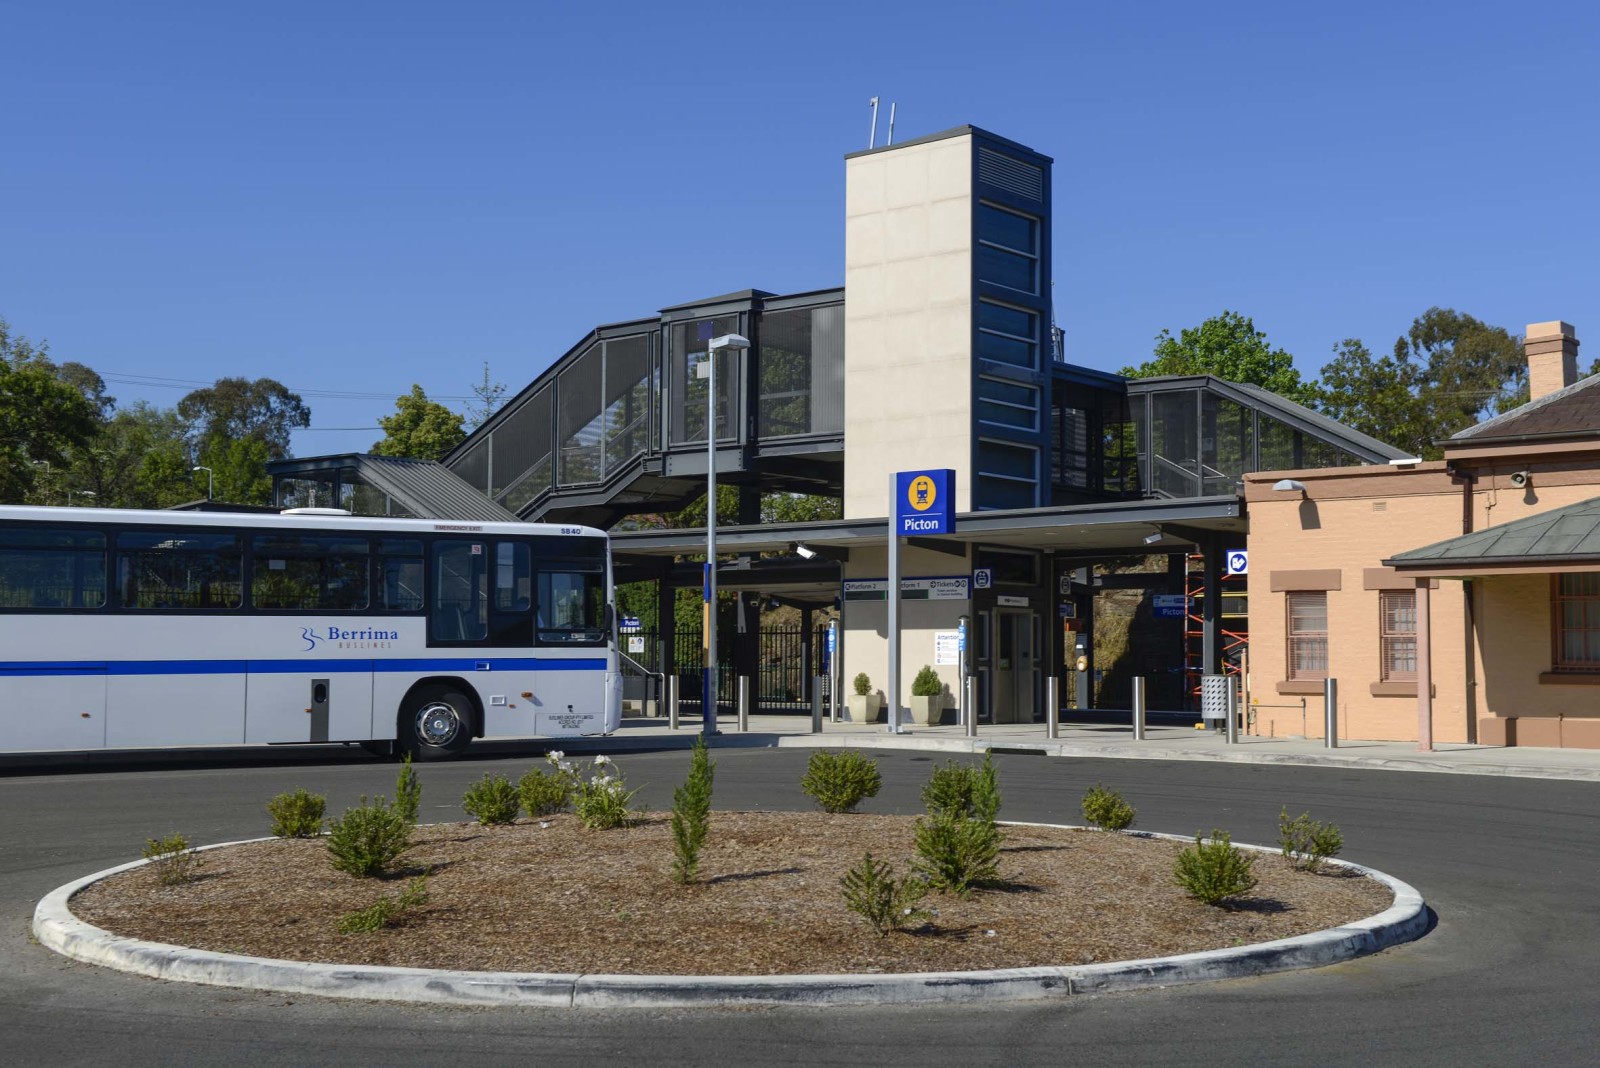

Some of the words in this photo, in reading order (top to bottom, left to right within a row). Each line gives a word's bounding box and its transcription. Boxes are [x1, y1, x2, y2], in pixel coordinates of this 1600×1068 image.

[904, 518, 939, 531] Picton
[328, 626, 399, 640] Berrima
[338, 641, 392, 649] BUSLINES
